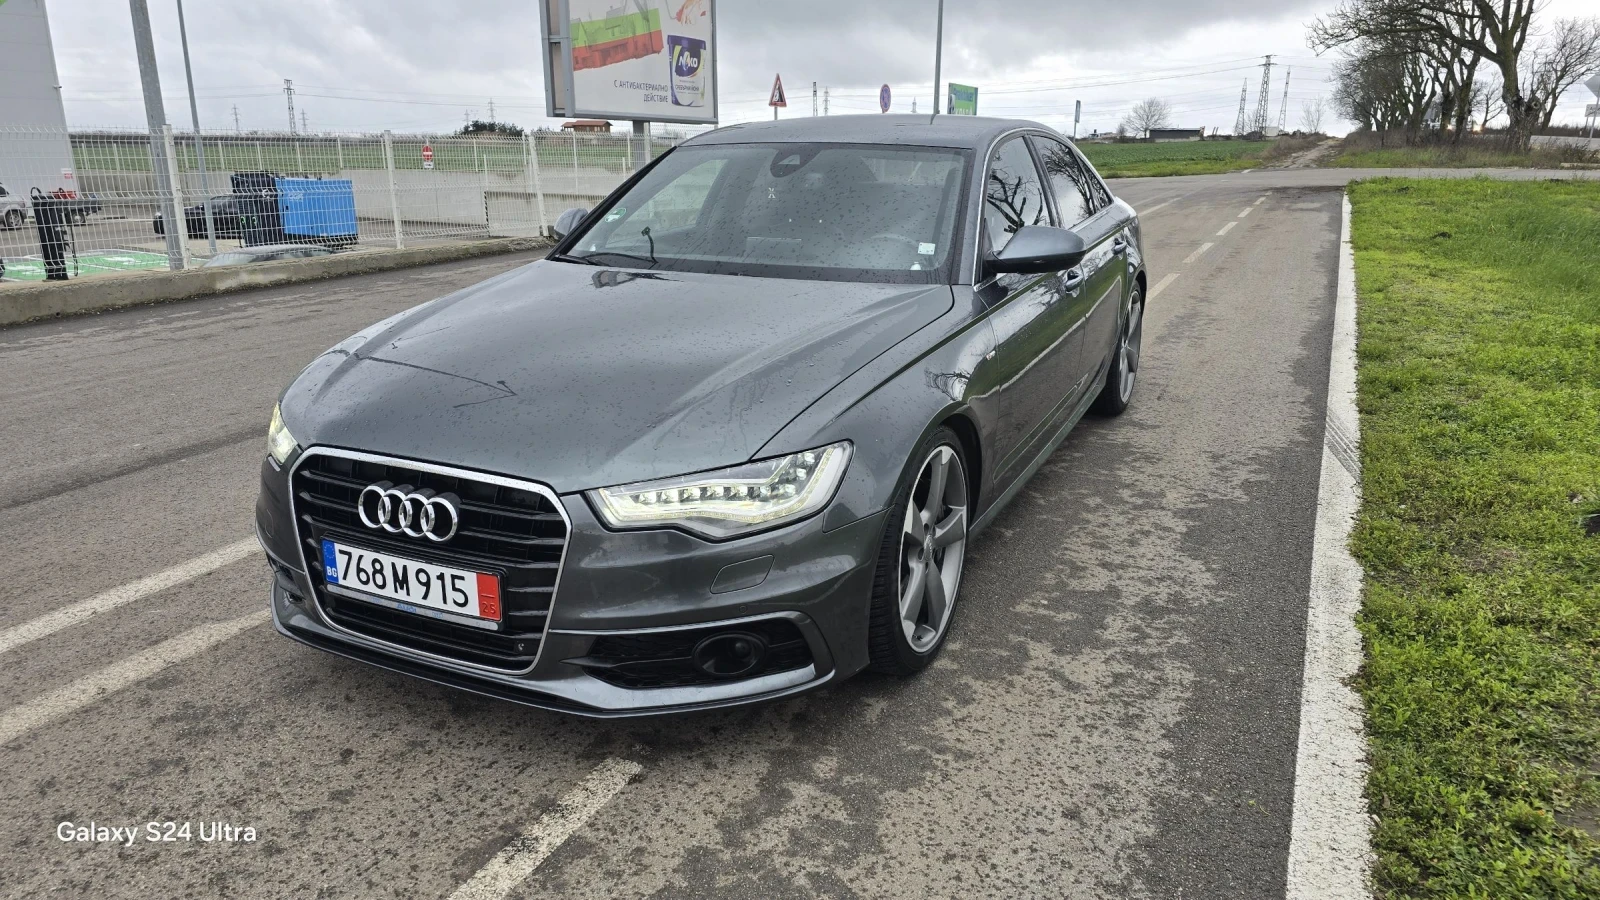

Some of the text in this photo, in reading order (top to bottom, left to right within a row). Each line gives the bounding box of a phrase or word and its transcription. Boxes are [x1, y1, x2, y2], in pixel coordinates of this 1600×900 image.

[619, 80, 668, 92] АНТИБАКТЕРИАЛНО
[644, 93, 668, 102] ДЕЙСТВИЕ
[326, 566, 337, 578] BG
[482, 601, 496, 615] 25
